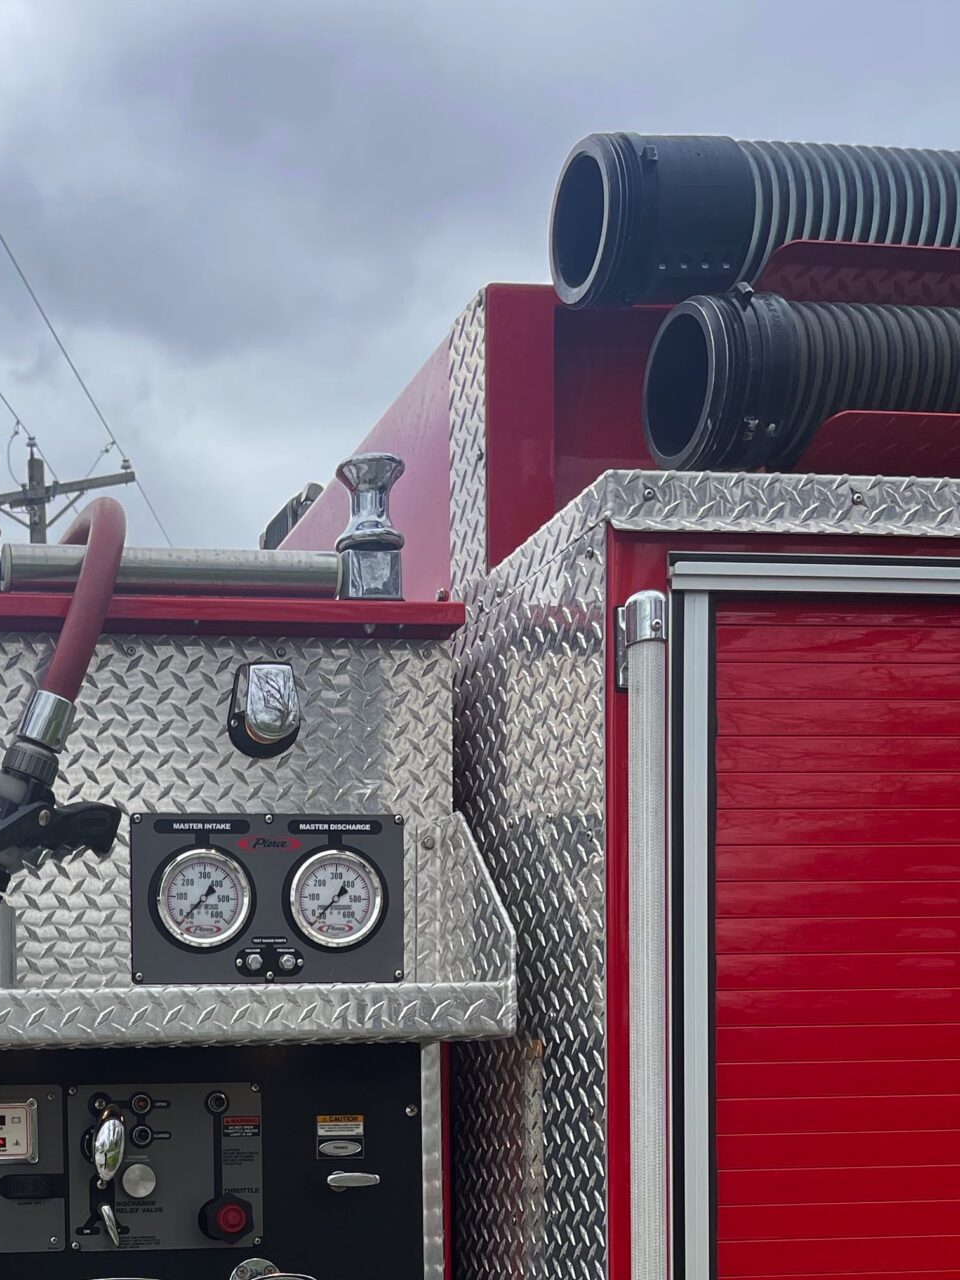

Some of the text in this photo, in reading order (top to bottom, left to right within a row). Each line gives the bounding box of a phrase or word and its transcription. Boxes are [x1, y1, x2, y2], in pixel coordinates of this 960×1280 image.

[299, 823, 328, 831] MASTER
[252, 837, 289, 849] Pierce
[198, 871, 211, 879] 300
[330, 872, 342, 880] 300
[314, 879, 326, 887] 200
[176, 892, 187, 900] 100
[308, 893, 320, 901] 100
